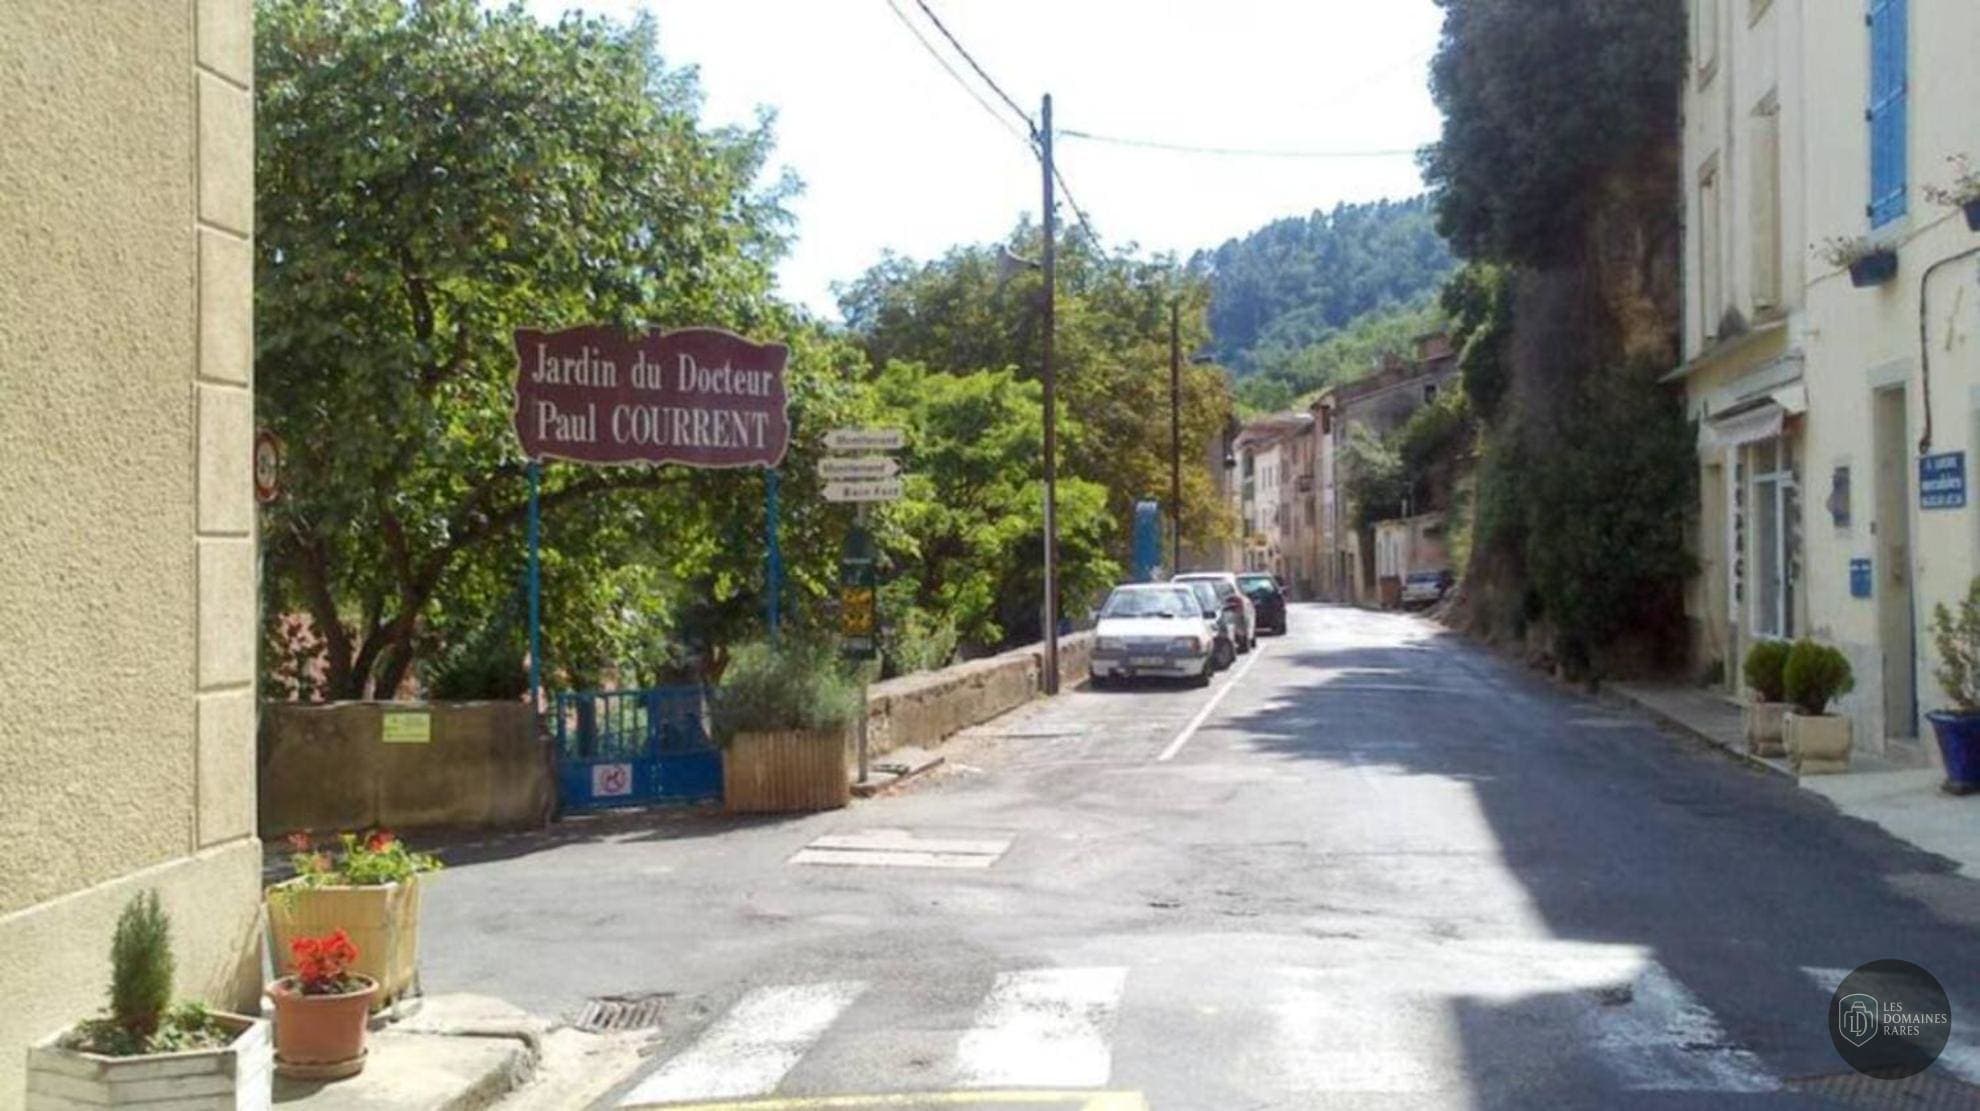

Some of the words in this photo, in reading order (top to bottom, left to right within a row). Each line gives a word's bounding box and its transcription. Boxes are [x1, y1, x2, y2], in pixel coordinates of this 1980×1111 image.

[532, 343, 617, 388] Jardin
[631, 351, 662, 390] du
[678, 353, 774, 397] Docteur
[537, 401, 597, 443] Paul
[612, 404, 770, 449] COURRENT
